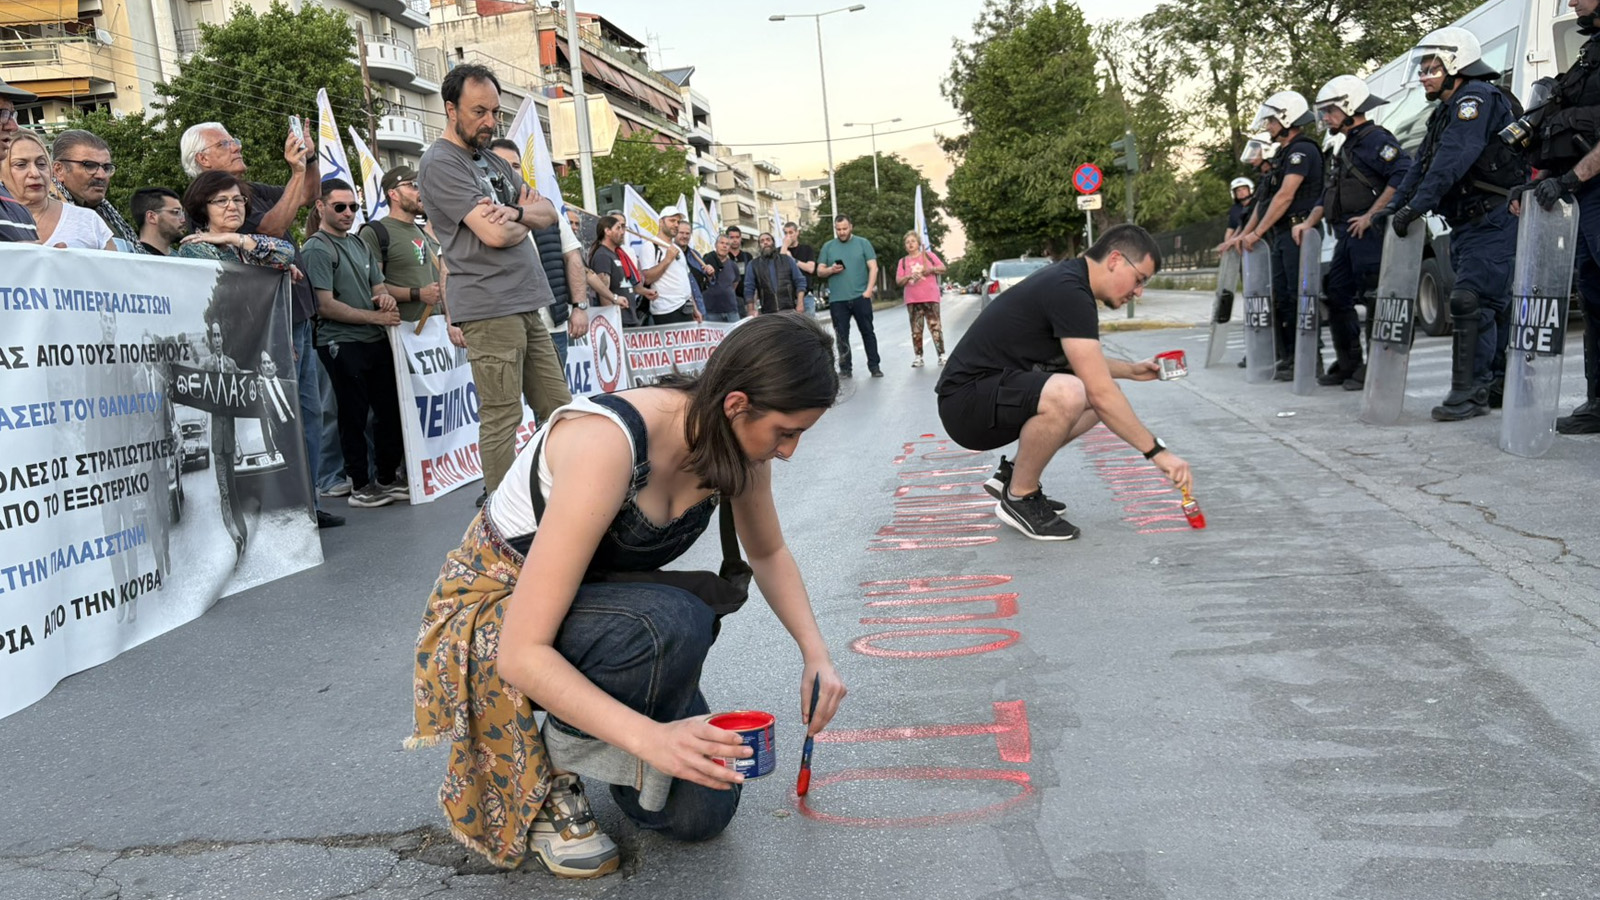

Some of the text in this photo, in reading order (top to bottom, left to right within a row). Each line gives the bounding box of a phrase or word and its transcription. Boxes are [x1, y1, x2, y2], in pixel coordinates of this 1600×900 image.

[0, 287, 171, 315] ΤΩΝ ΙΜΠΕΡΙΑΛΙΣΤΩΝ
[37, 344, 74, 367] ΑΠΟ
[77, 344, 116, 365] ΤΟΥΣ
[120, 343, 190, 363] ΠΟΛΕΜΟΥΣ
[60, 398, 95, 422] ΤΟΥ
[98, 392, 162, 418] ΘΑΝΑΤΟΥ
[51, 456, 69, 481] ΟΙ
[75, 438, 175, 476] ΣΤΡΑΤΙΩΤΙΚΕΣ
[44, 493, 59, 518] ΤΟ
[64, 472, 149, 511] ΕΞΩΤΕΡΙΚΟ
[0, 523, 147, 594] ΤΗΝ ΠΑΛΑΙΣΤΙΝΗ
[44, 604, 66, 639] ΑΠΟ
[70, 588, 115, 620] ΤΗΝ
[120, 569, 162, 604] ΚΟΥΒΑ
